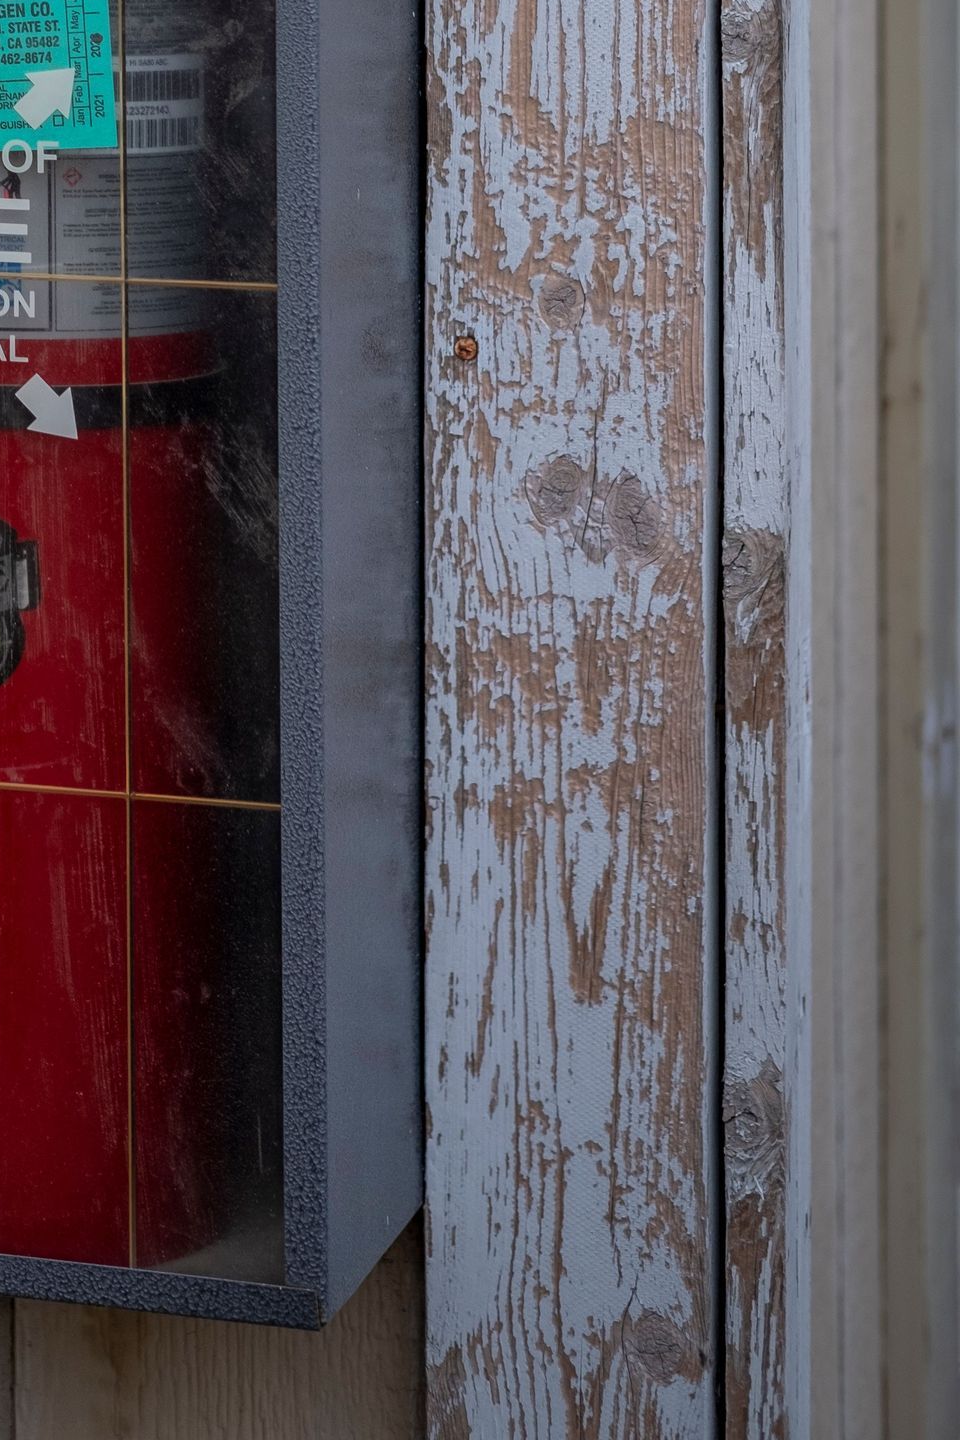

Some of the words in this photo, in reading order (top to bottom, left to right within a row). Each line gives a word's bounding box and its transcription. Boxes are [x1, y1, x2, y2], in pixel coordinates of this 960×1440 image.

[30, 2, 54, 17] CO.
[8, 21, 41, 34] STATE
[44, 20, 61, 32] ST.
[70, 10, 79, 29] May
[7, 37, 22, 50] CA
[25, 36, 60, 48] 95482
[72, 38, 81, 53] Apr
[75, 85, 83, 103] Feb
[95, 94, 104, 118] 2021
[77, 109, 85, 125] Jan
[2, 140, 60, 174] OF
